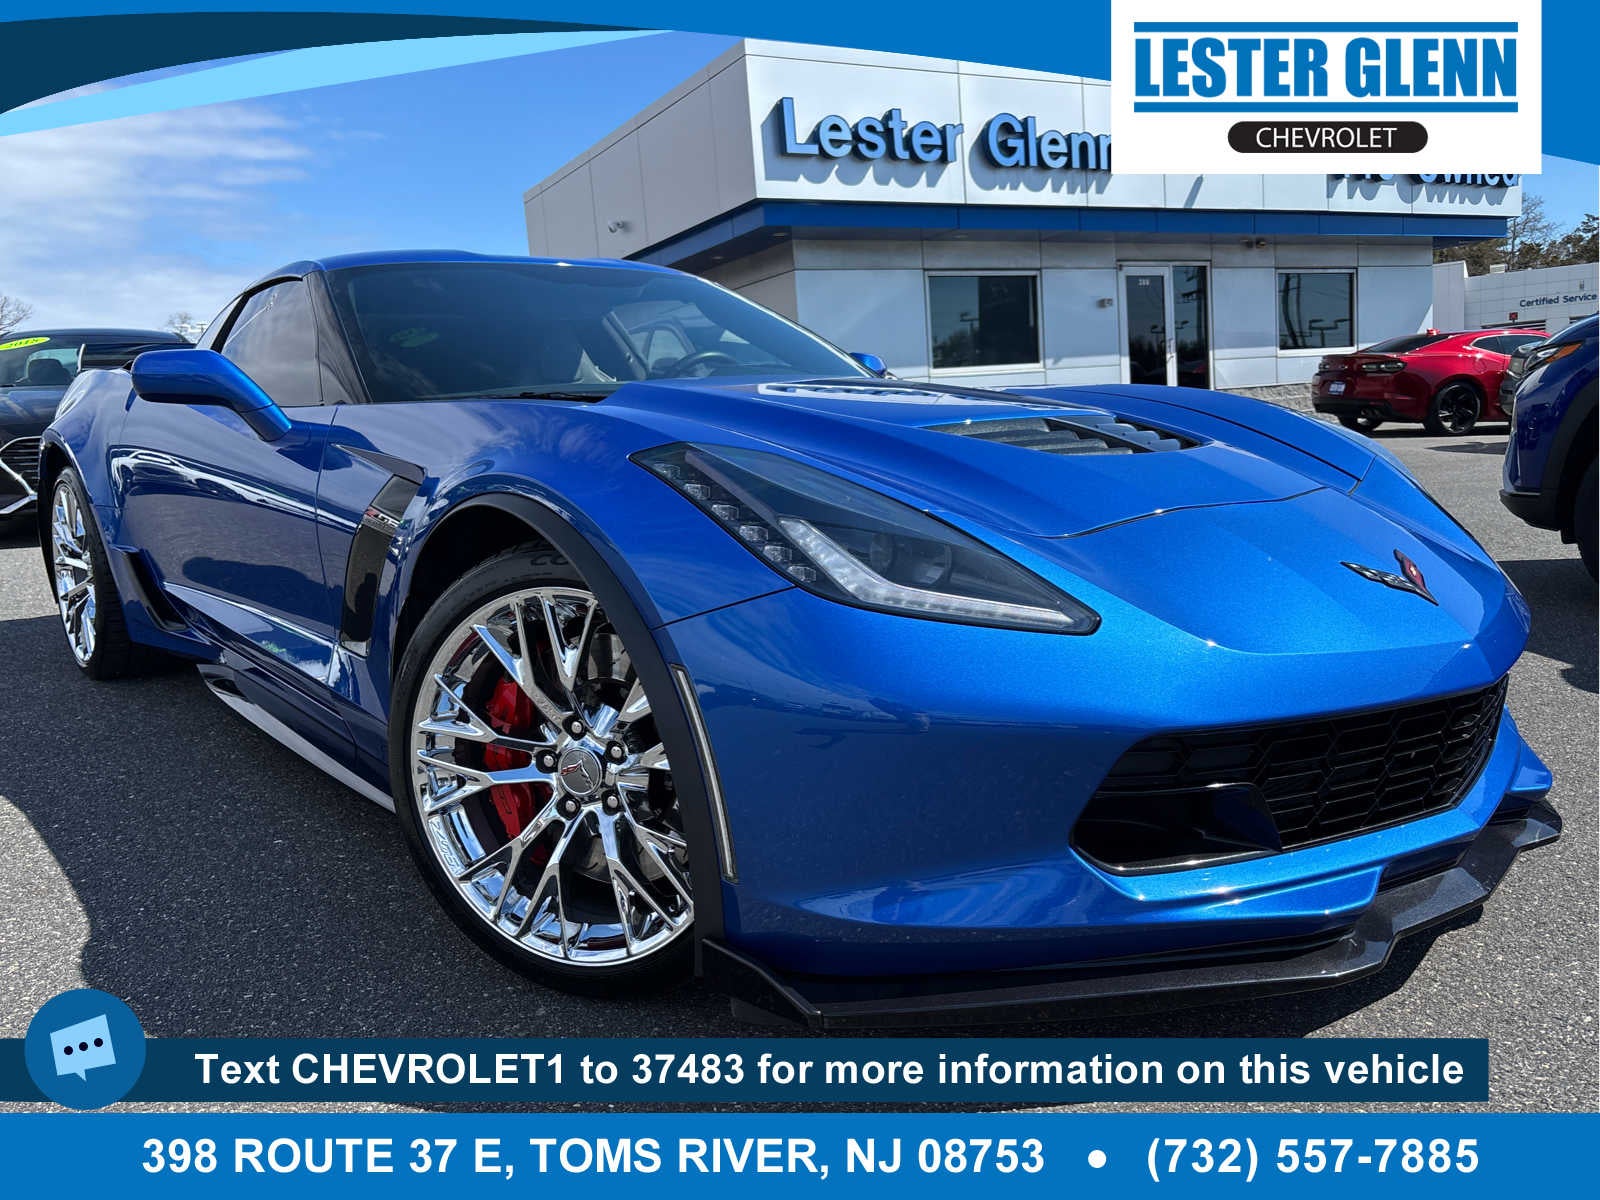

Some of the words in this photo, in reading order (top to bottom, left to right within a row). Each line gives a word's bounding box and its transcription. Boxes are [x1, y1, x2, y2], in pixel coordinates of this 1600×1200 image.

[778, 97, 963, 163] Lester
[1519, 296, 1560, 308] Certified
[1563, 293, 1598, 304] Service
